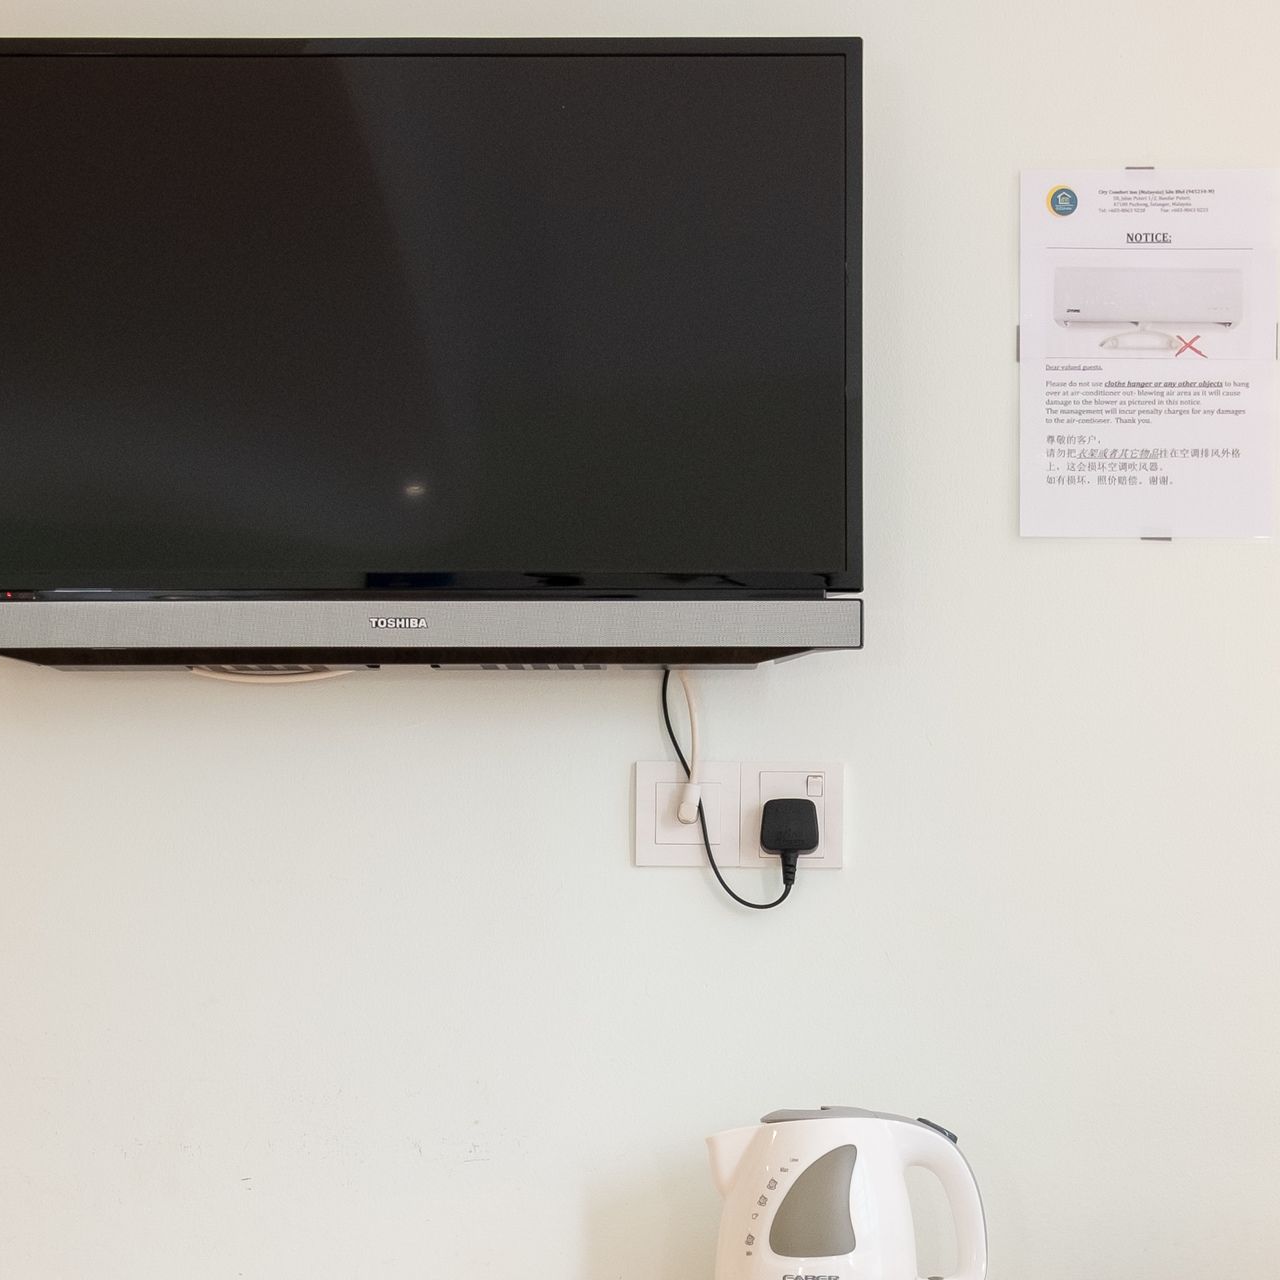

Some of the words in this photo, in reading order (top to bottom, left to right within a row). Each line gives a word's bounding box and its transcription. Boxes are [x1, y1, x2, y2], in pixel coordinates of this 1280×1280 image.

[1126, 233, 1172, 243] NOTICE:
[1137, 390, 1164, 398] blowing
[1045, 399, 1072, 407] damage
[1128, 399, 1156, 407] pictured
[1059, 408, 1103, 416] management
[1137, 408, 1162, 416] penalty
[1164, 408, 1190, 416] charges
[1216, 408, 1246, 416] damages
[369, 617, 428, 628] TOSHIBA
